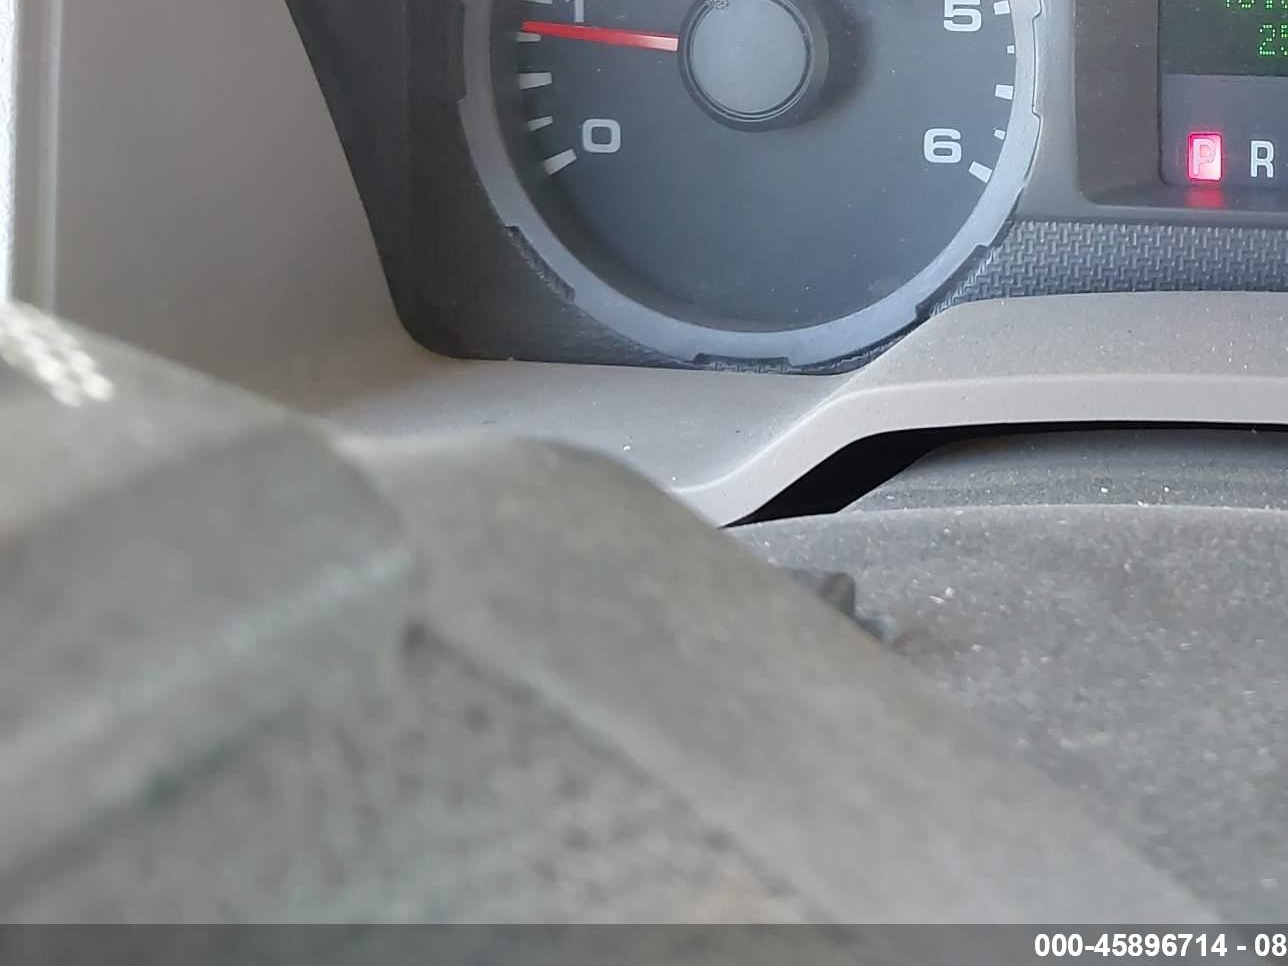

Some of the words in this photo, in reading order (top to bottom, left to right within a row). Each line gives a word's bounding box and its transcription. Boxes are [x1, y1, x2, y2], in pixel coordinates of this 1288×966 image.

[583, 119, 620, 153] 0
[924, 129, 961, 163] 6
[1192, 137, 1217, 176] P
[1251, 141, 1273, 177] R
